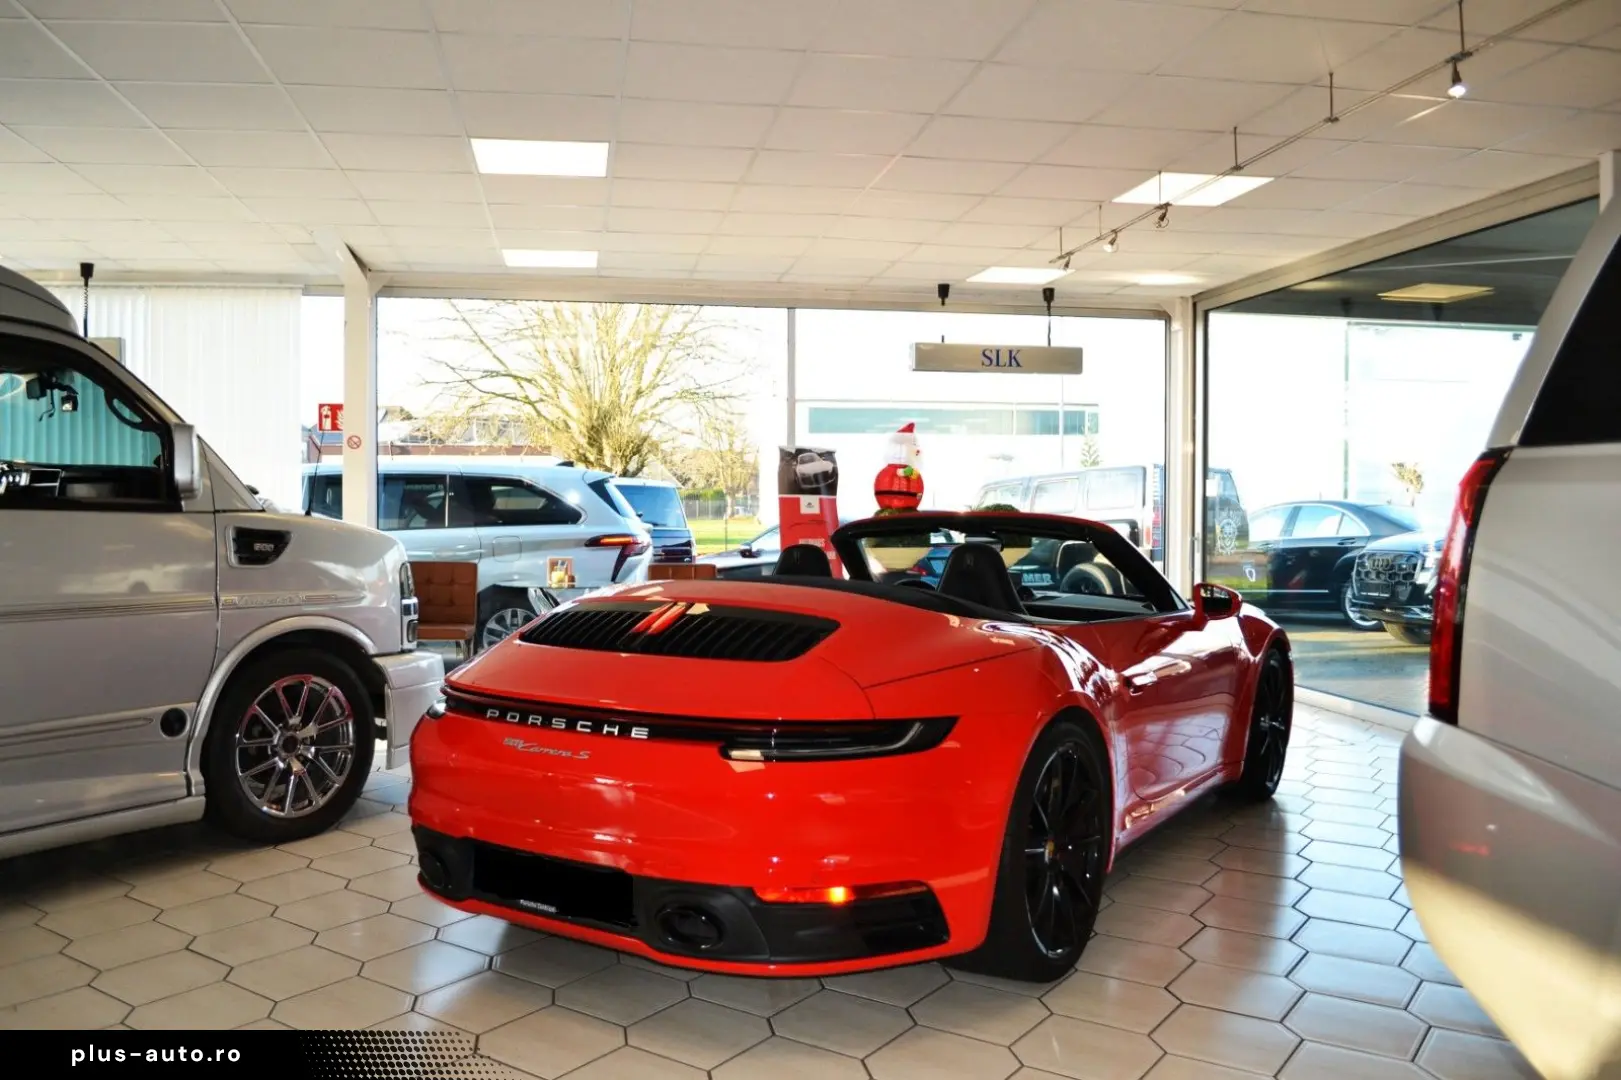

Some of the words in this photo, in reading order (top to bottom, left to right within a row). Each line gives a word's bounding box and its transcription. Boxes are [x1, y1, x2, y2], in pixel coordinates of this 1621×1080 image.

[981, 347, 1023, 368] SLK
[486, 709, 649, 738] PORSCHE
[518, 743, 572, 756] Carrera
[574, 751, 591, 759] S
